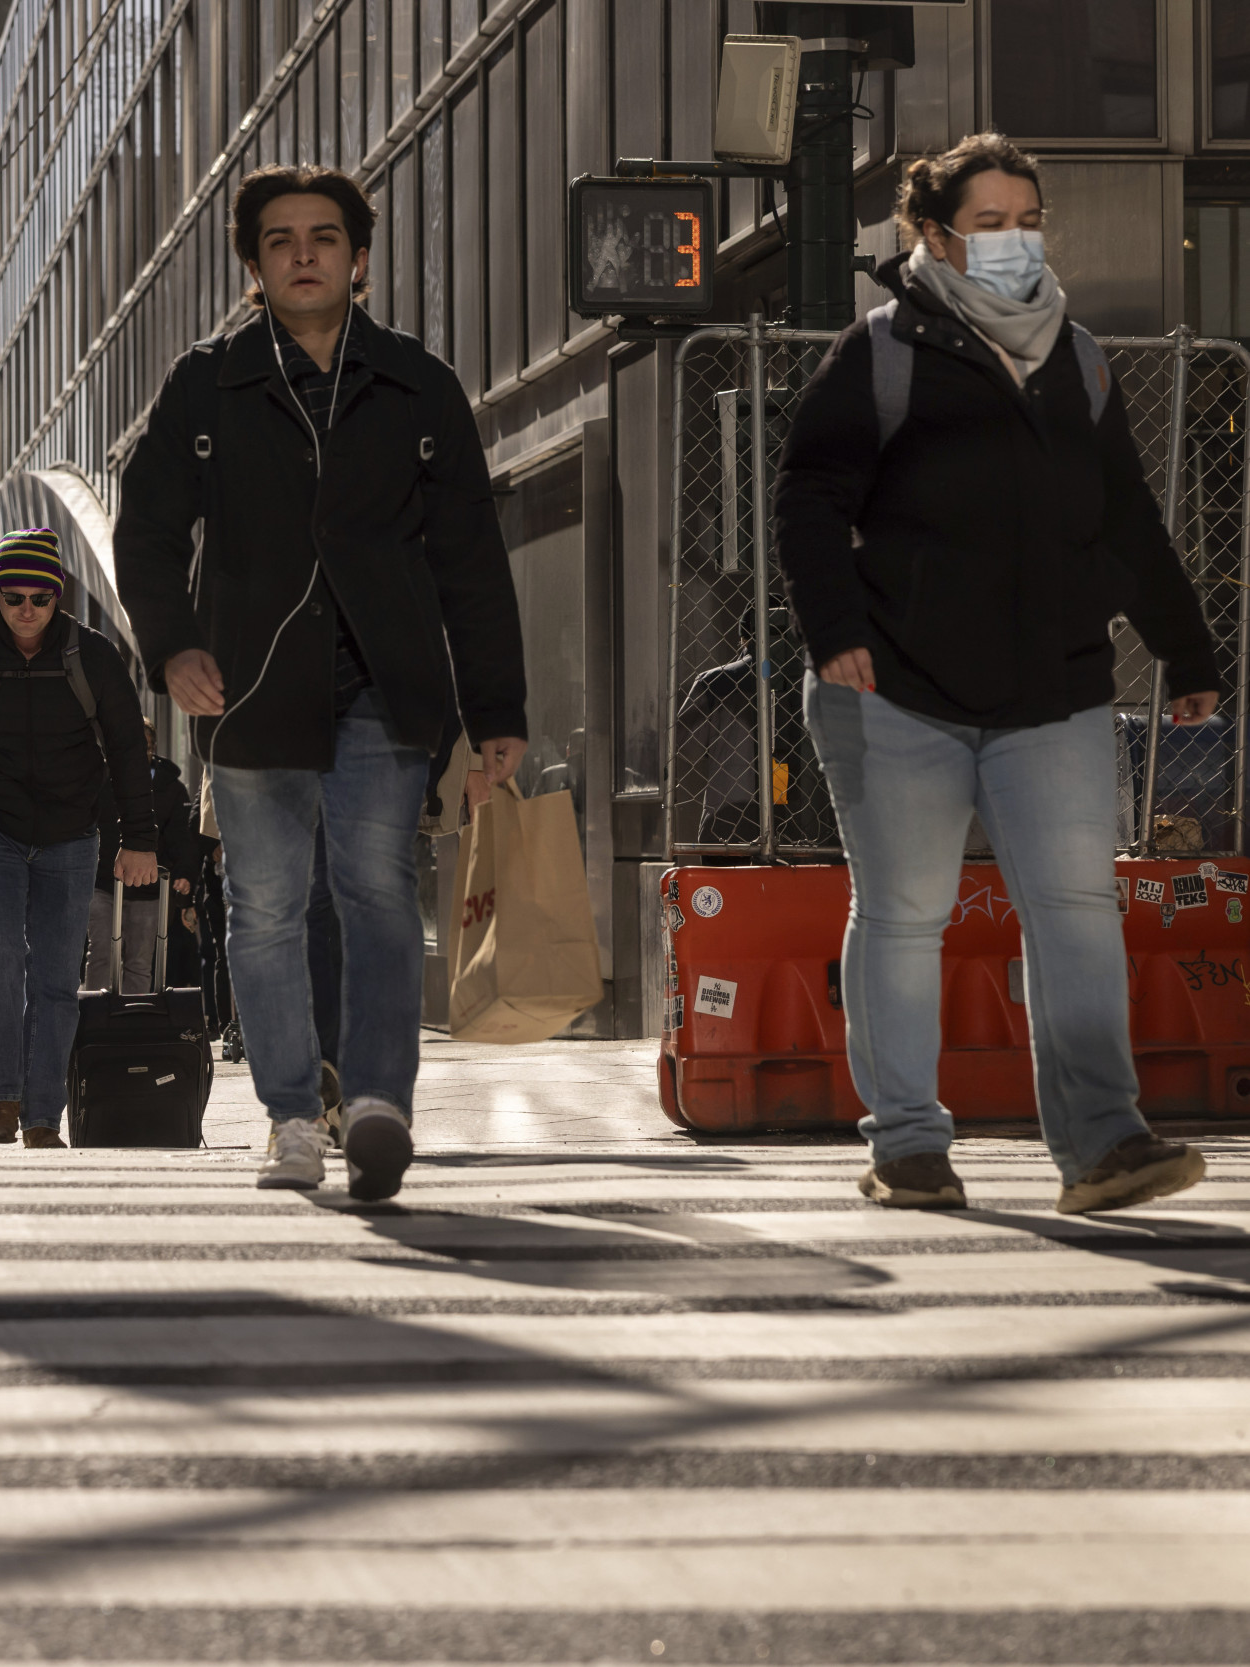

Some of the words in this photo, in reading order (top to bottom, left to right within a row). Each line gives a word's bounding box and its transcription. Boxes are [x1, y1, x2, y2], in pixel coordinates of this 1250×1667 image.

[673, 212, 700, 287] 3
[1139, 880, 1163, 894] MIJ
[1136, 890, 1161, 903] XXX
[1175, 891, 1207, 906] TEKS
